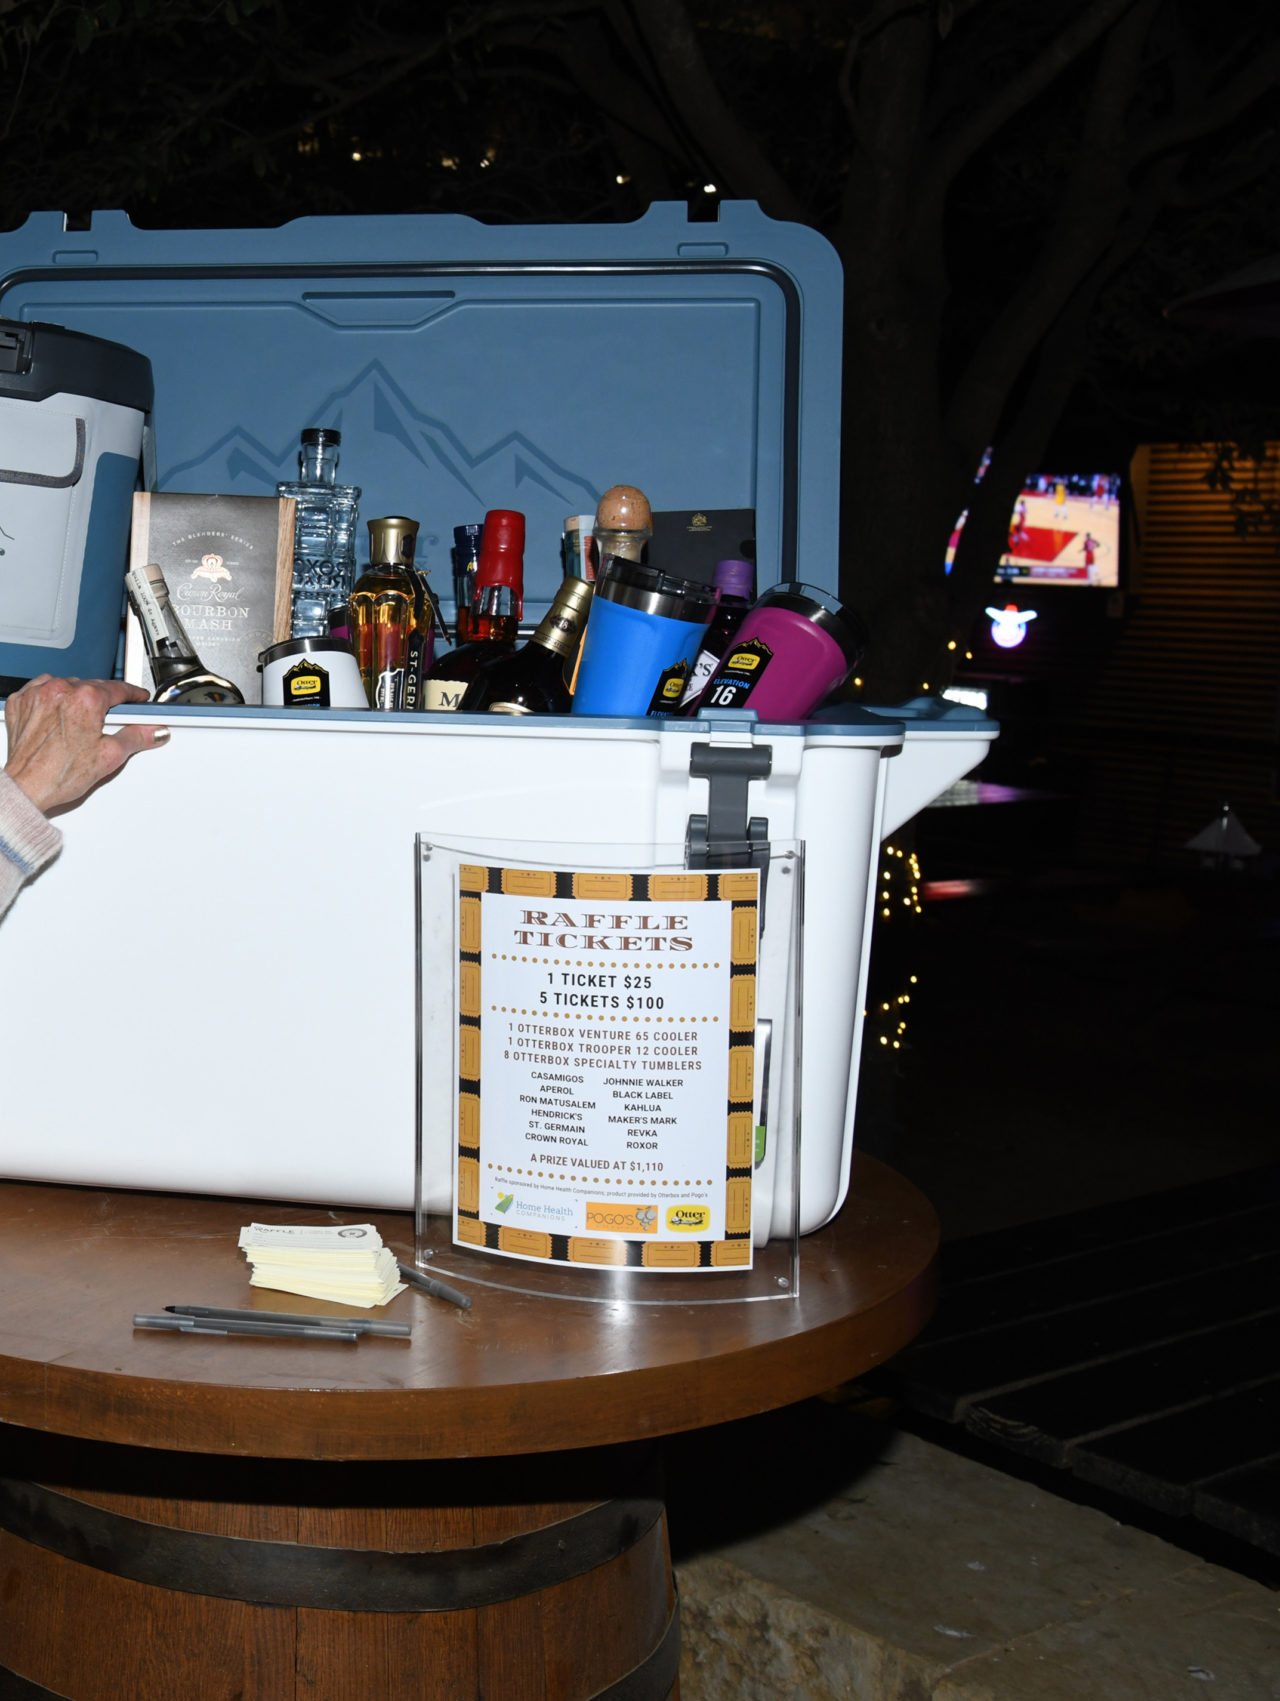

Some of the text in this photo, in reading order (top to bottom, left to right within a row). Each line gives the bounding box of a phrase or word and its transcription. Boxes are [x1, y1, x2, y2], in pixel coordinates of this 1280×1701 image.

[172, 538, 185, 546] THE
[176, 583, 245, 602] Crown Royal
[184, 619, 233, 630] MASH
[407, 651, 418, 709] ST-GER
[713, 678, 750, 689] ELEVATION
[710, 685, 736, 705] 16
[519, 909, 689, 930] RAFFLE
[513, 930, 694, 952] TICKETS
[547, 972, 652, 990] 1 TICKET $25
[540, 992, 664, 1011] 5 TICKETS $100
[508, 1022, 698, 1042] 1 OTTERBOX VENTURE 65 COOLER
[508, 1037, 698, 1056] 1 OTTERBOX TROOPER 12 COOLER
[504, 1050, 702, 1071] 8 OTTERBOX SPECIALTY TUMBLERS
[531, 1071, 584, 1084] CASAMIGOS
[603, 1077, 683, 1088] JOHNNIE WALKER
[540, 1085, 574, 1096] APEROL
[612, 1090, 673, 1100] BLACK LABEL
[519, 1094, 596, 1110] RON MATUSALEM
[624, 1103, 662, 1112] KAHLUA
[531, 1108, 583, 1121] HENDRICK'S
[608, 1115, 677, 1125] MAKER'S MARK
[528, 1120, 585, 1134] ST. GERMAIN
[627, 1128, 658, 1137] REVKA
[525, 1132, 589, 1147] CROWN ROYAL
[626, 1141, 658, 1150] ROXOR
[530, 1153, 663, 1173] A PRIZE VALUED AT $1,110
[516, 1200, 573, 1216] Home Health
[676, 1210, 705, 1219] Otter
[516, 1210, 566, 1221] COMPANIONS
